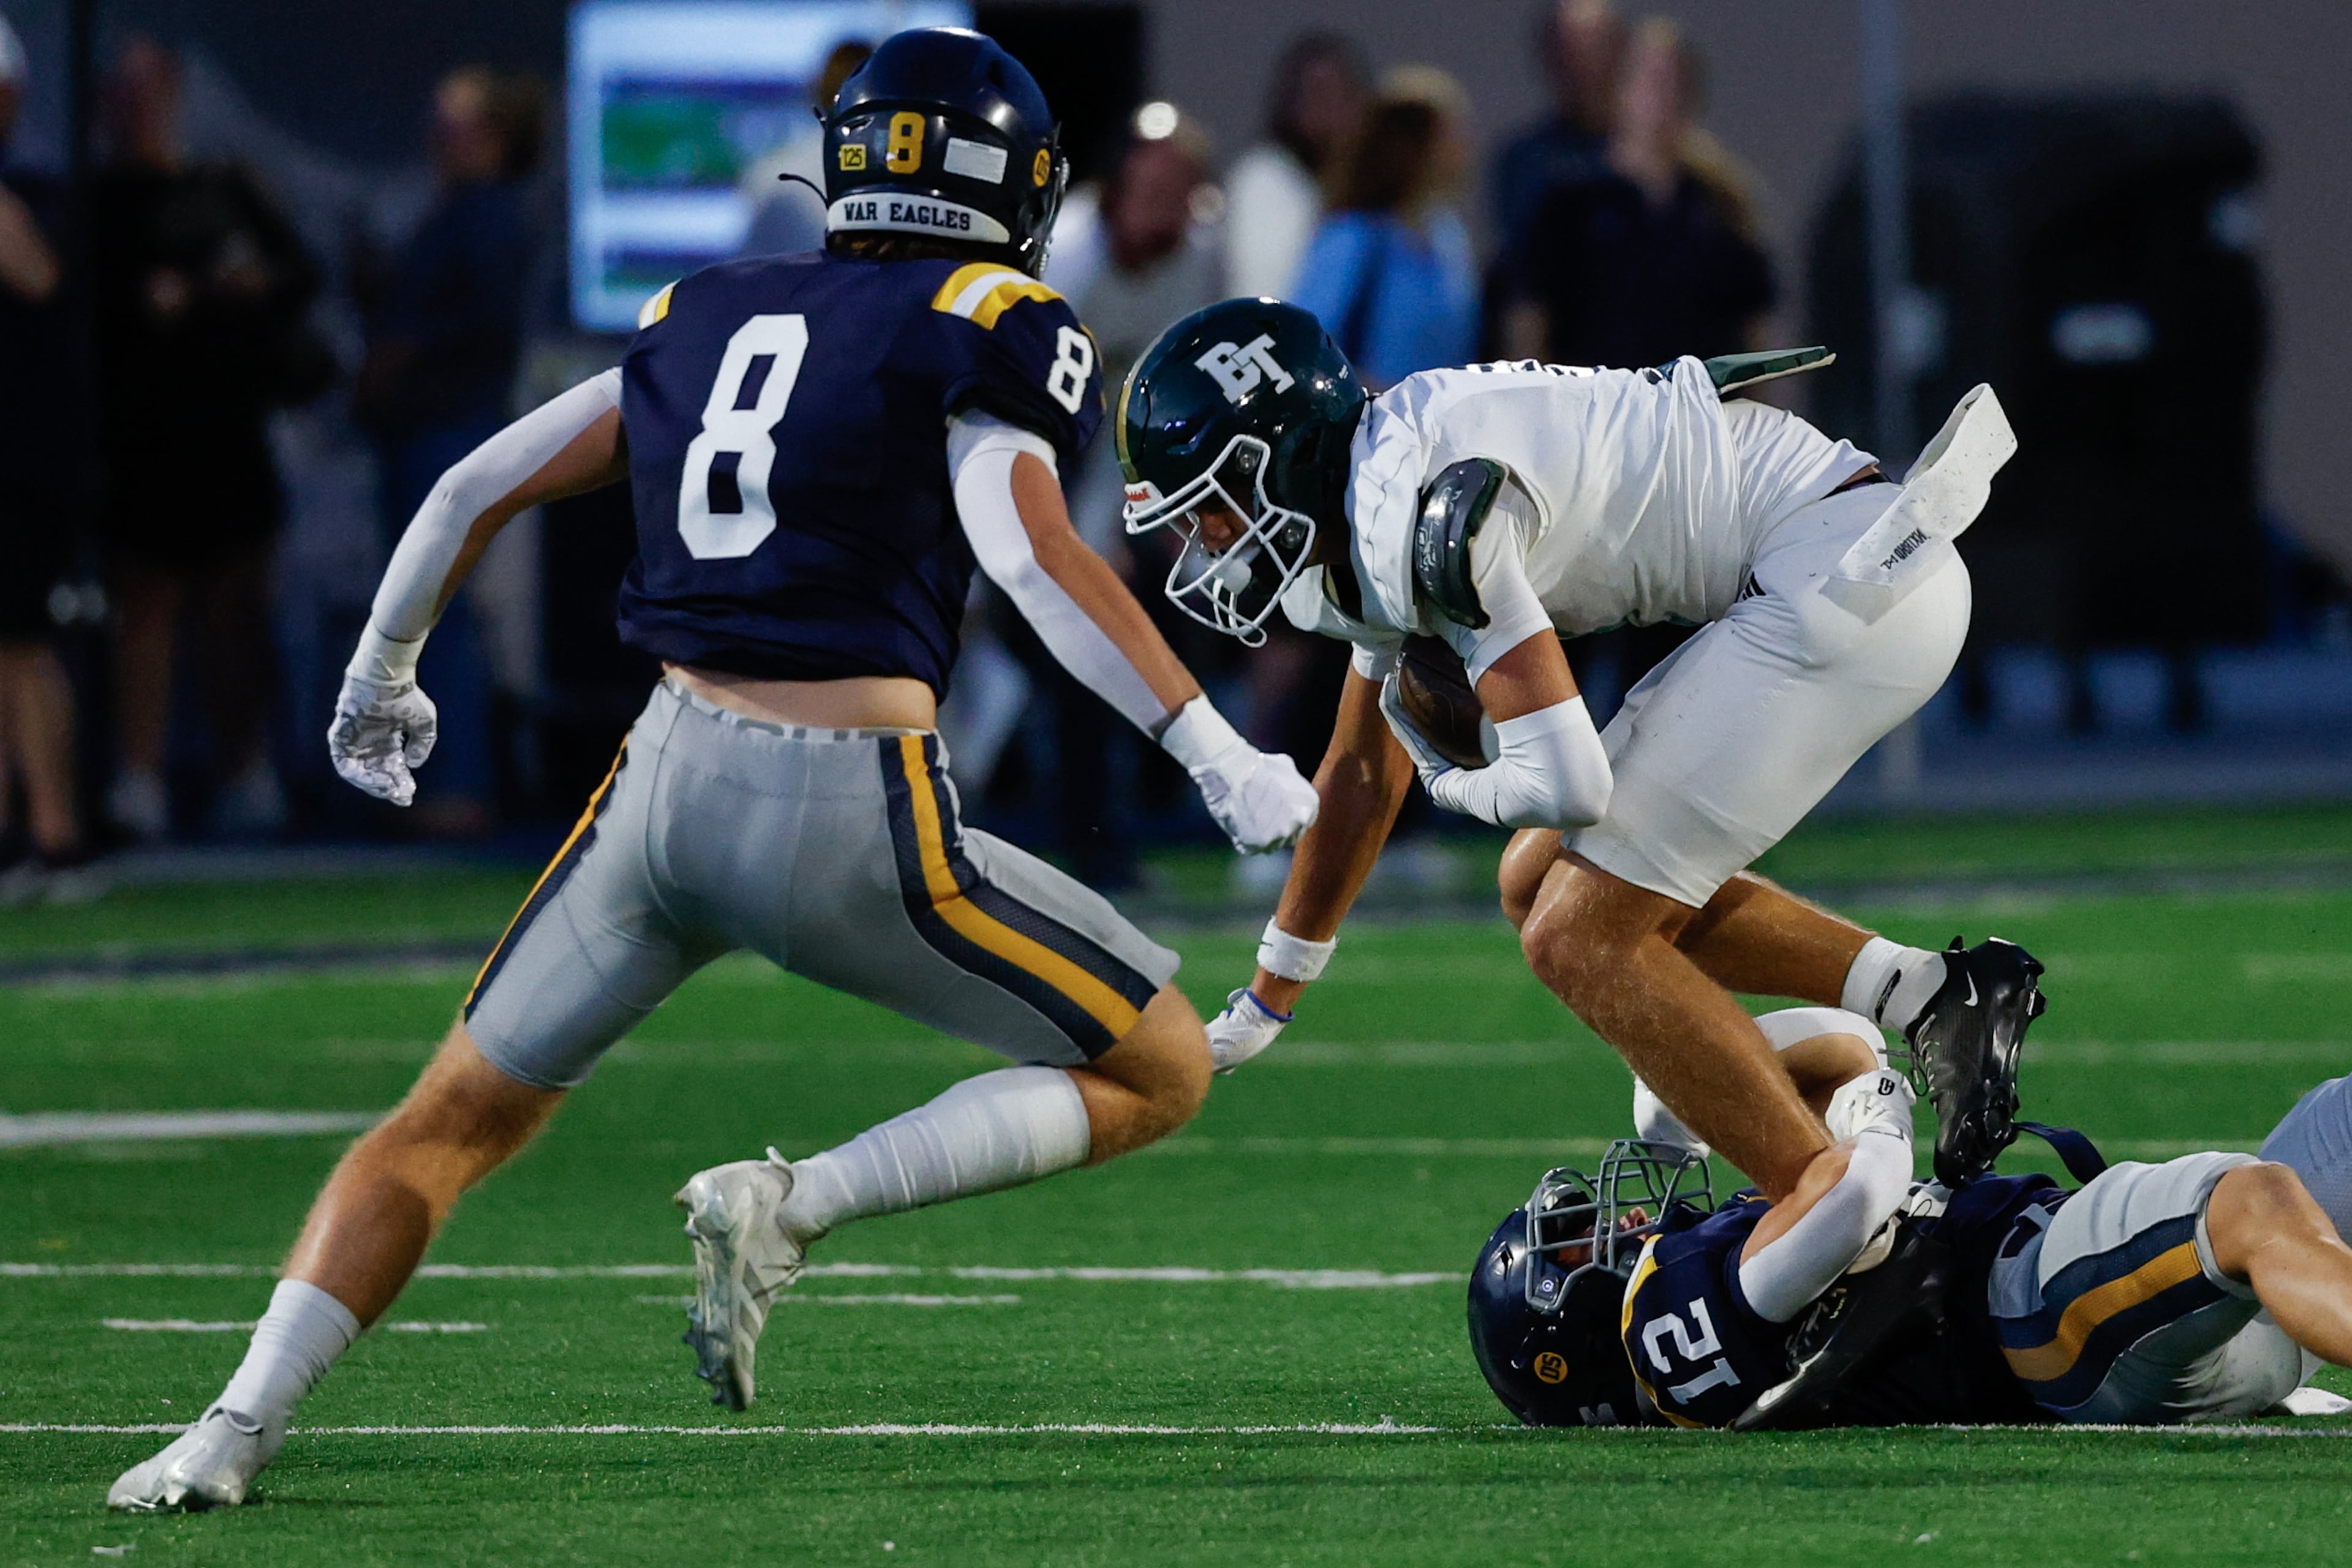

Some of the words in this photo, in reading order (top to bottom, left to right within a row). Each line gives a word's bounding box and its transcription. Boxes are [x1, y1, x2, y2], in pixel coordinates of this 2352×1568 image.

[843, 148, 863, 167] 125
[886, 111, 925, 174] 8
[844, 202, 877, 221] WAR
[890, 203, 970, 231] EAGLES
[1046, 325, 1094, 415] 8
[1194, 333, 1295, 404] BT
[678, 314, 810, 560] 8
[1540, 1354, 1562, 1381] DS
[1642, 1296, 1741, 1405] 12
